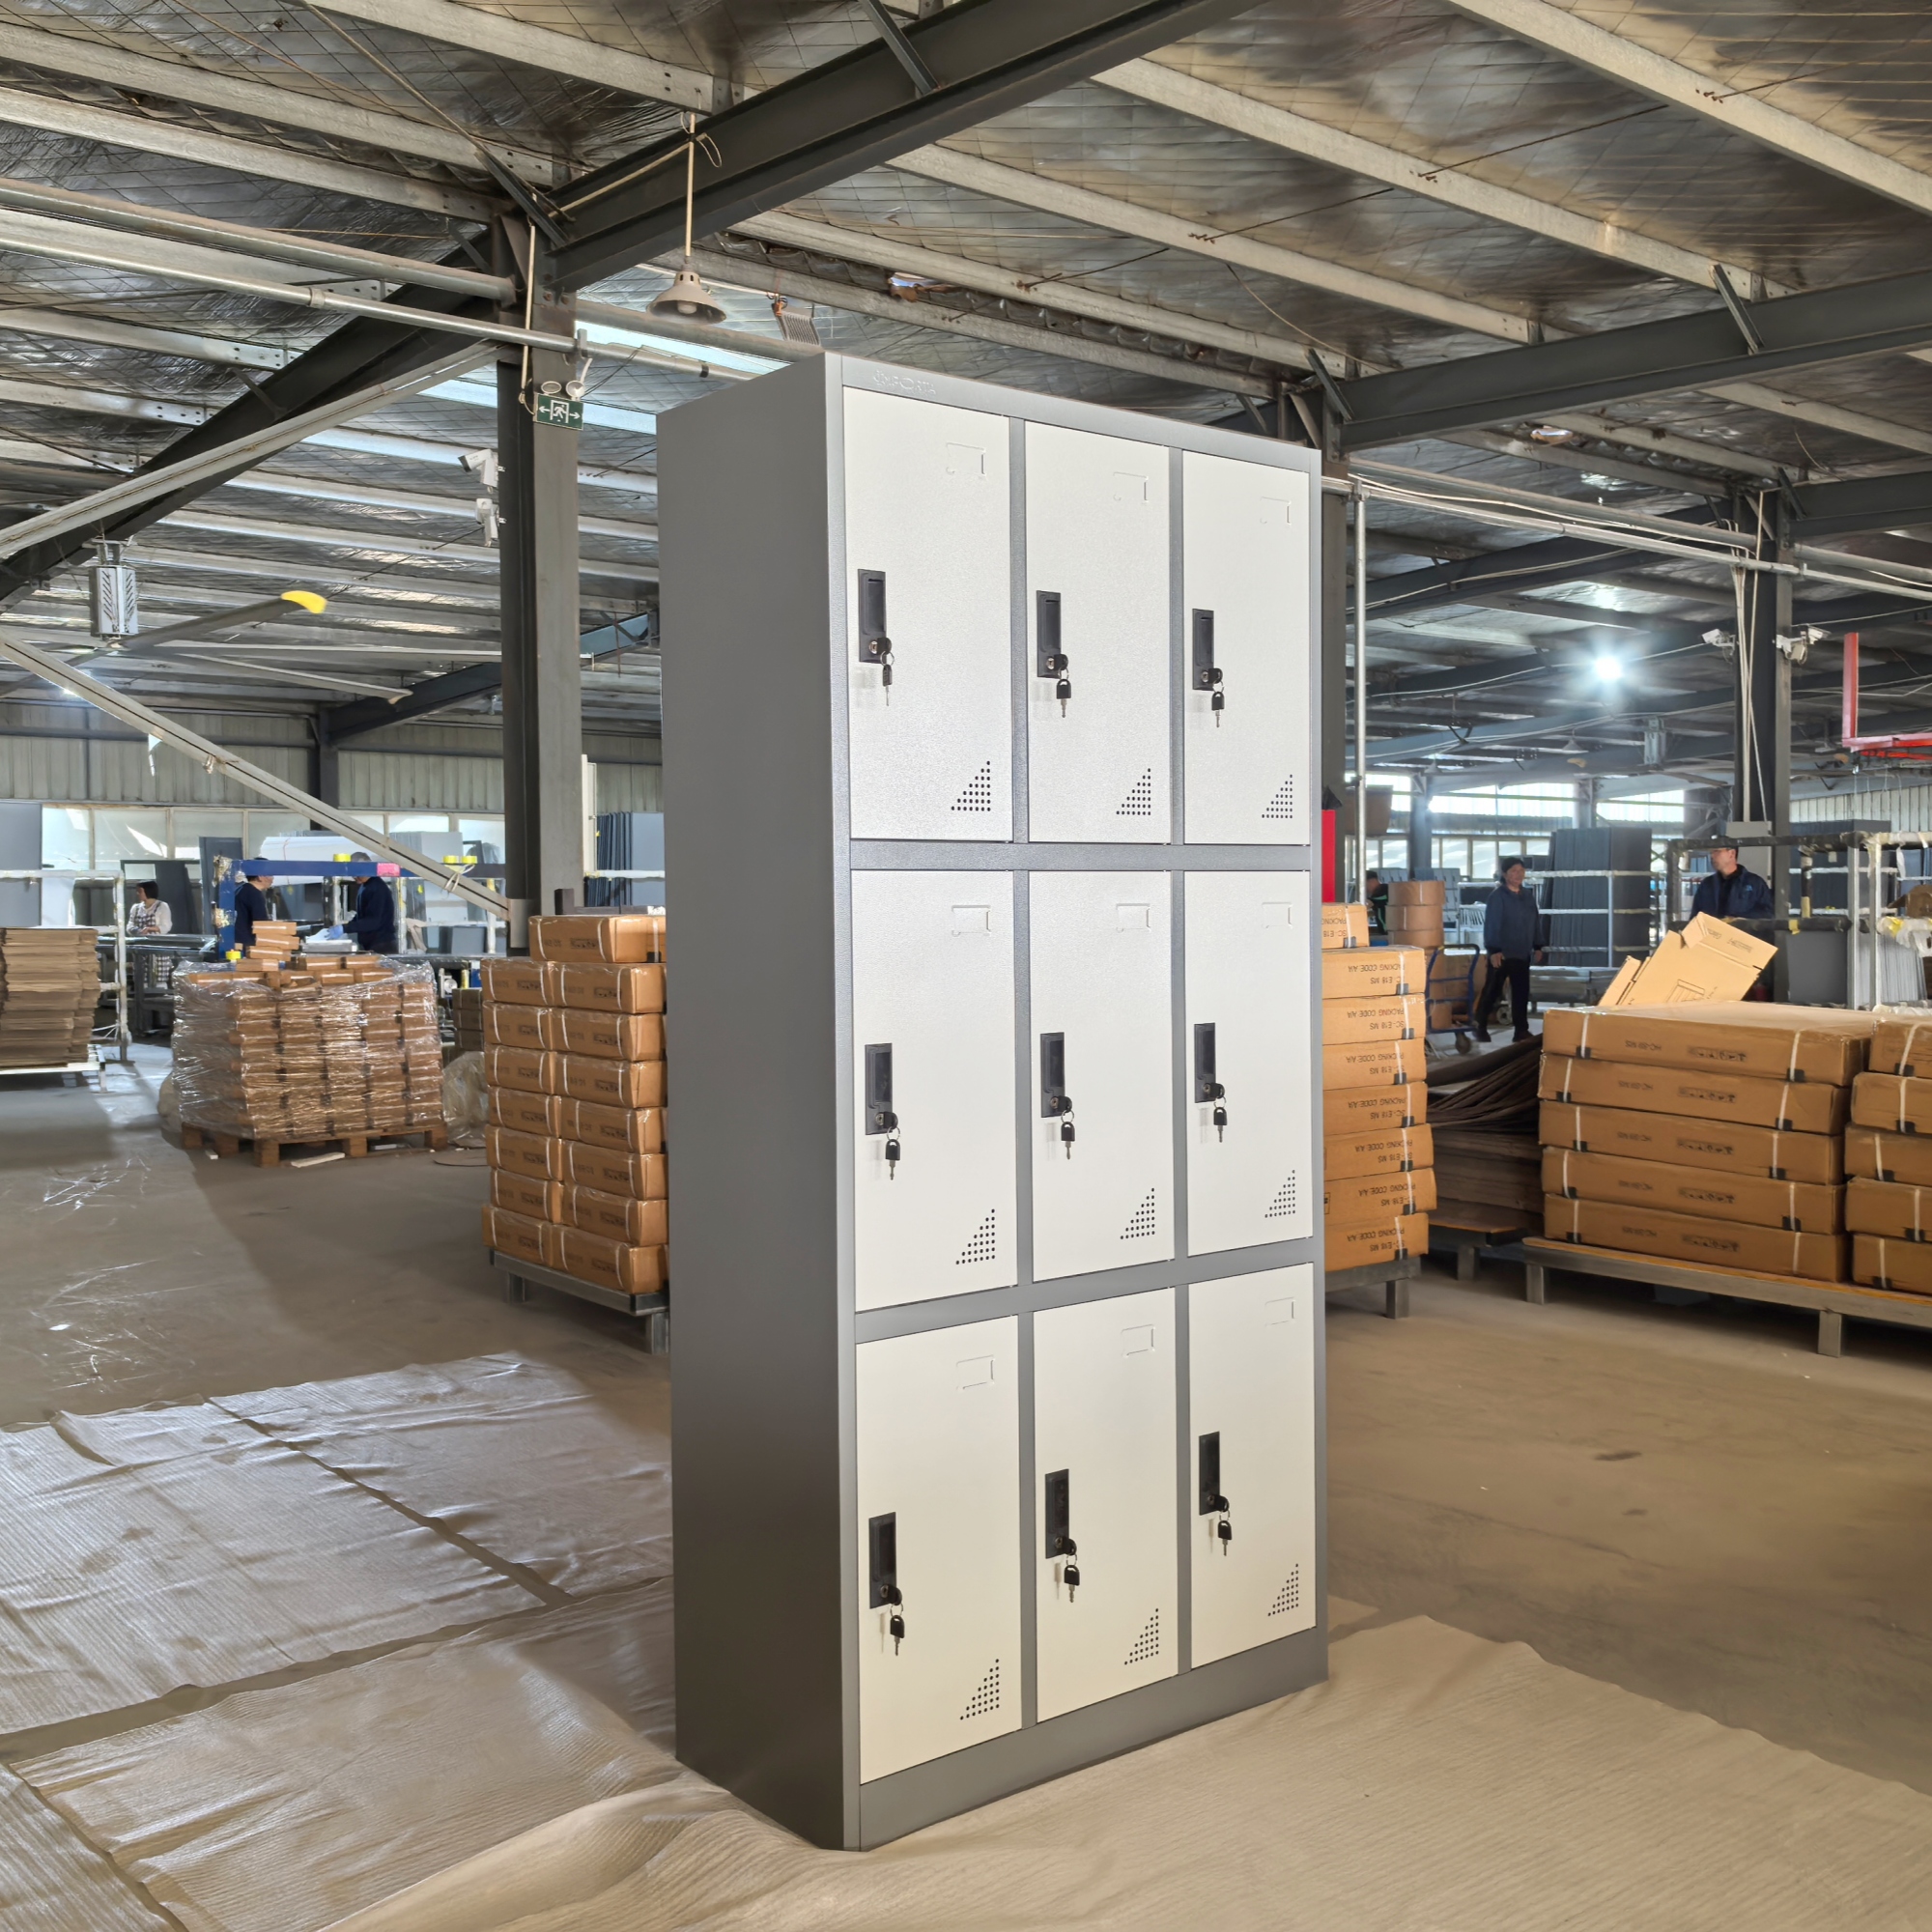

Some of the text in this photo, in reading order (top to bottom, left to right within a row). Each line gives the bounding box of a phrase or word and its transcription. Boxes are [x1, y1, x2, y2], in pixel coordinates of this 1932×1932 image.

[1378, 1052, 1404, 1061] PCKING
[1390, 1183, 1415, 1192] PCKING
[1378, 1228, 1405, 1237] PCKING
